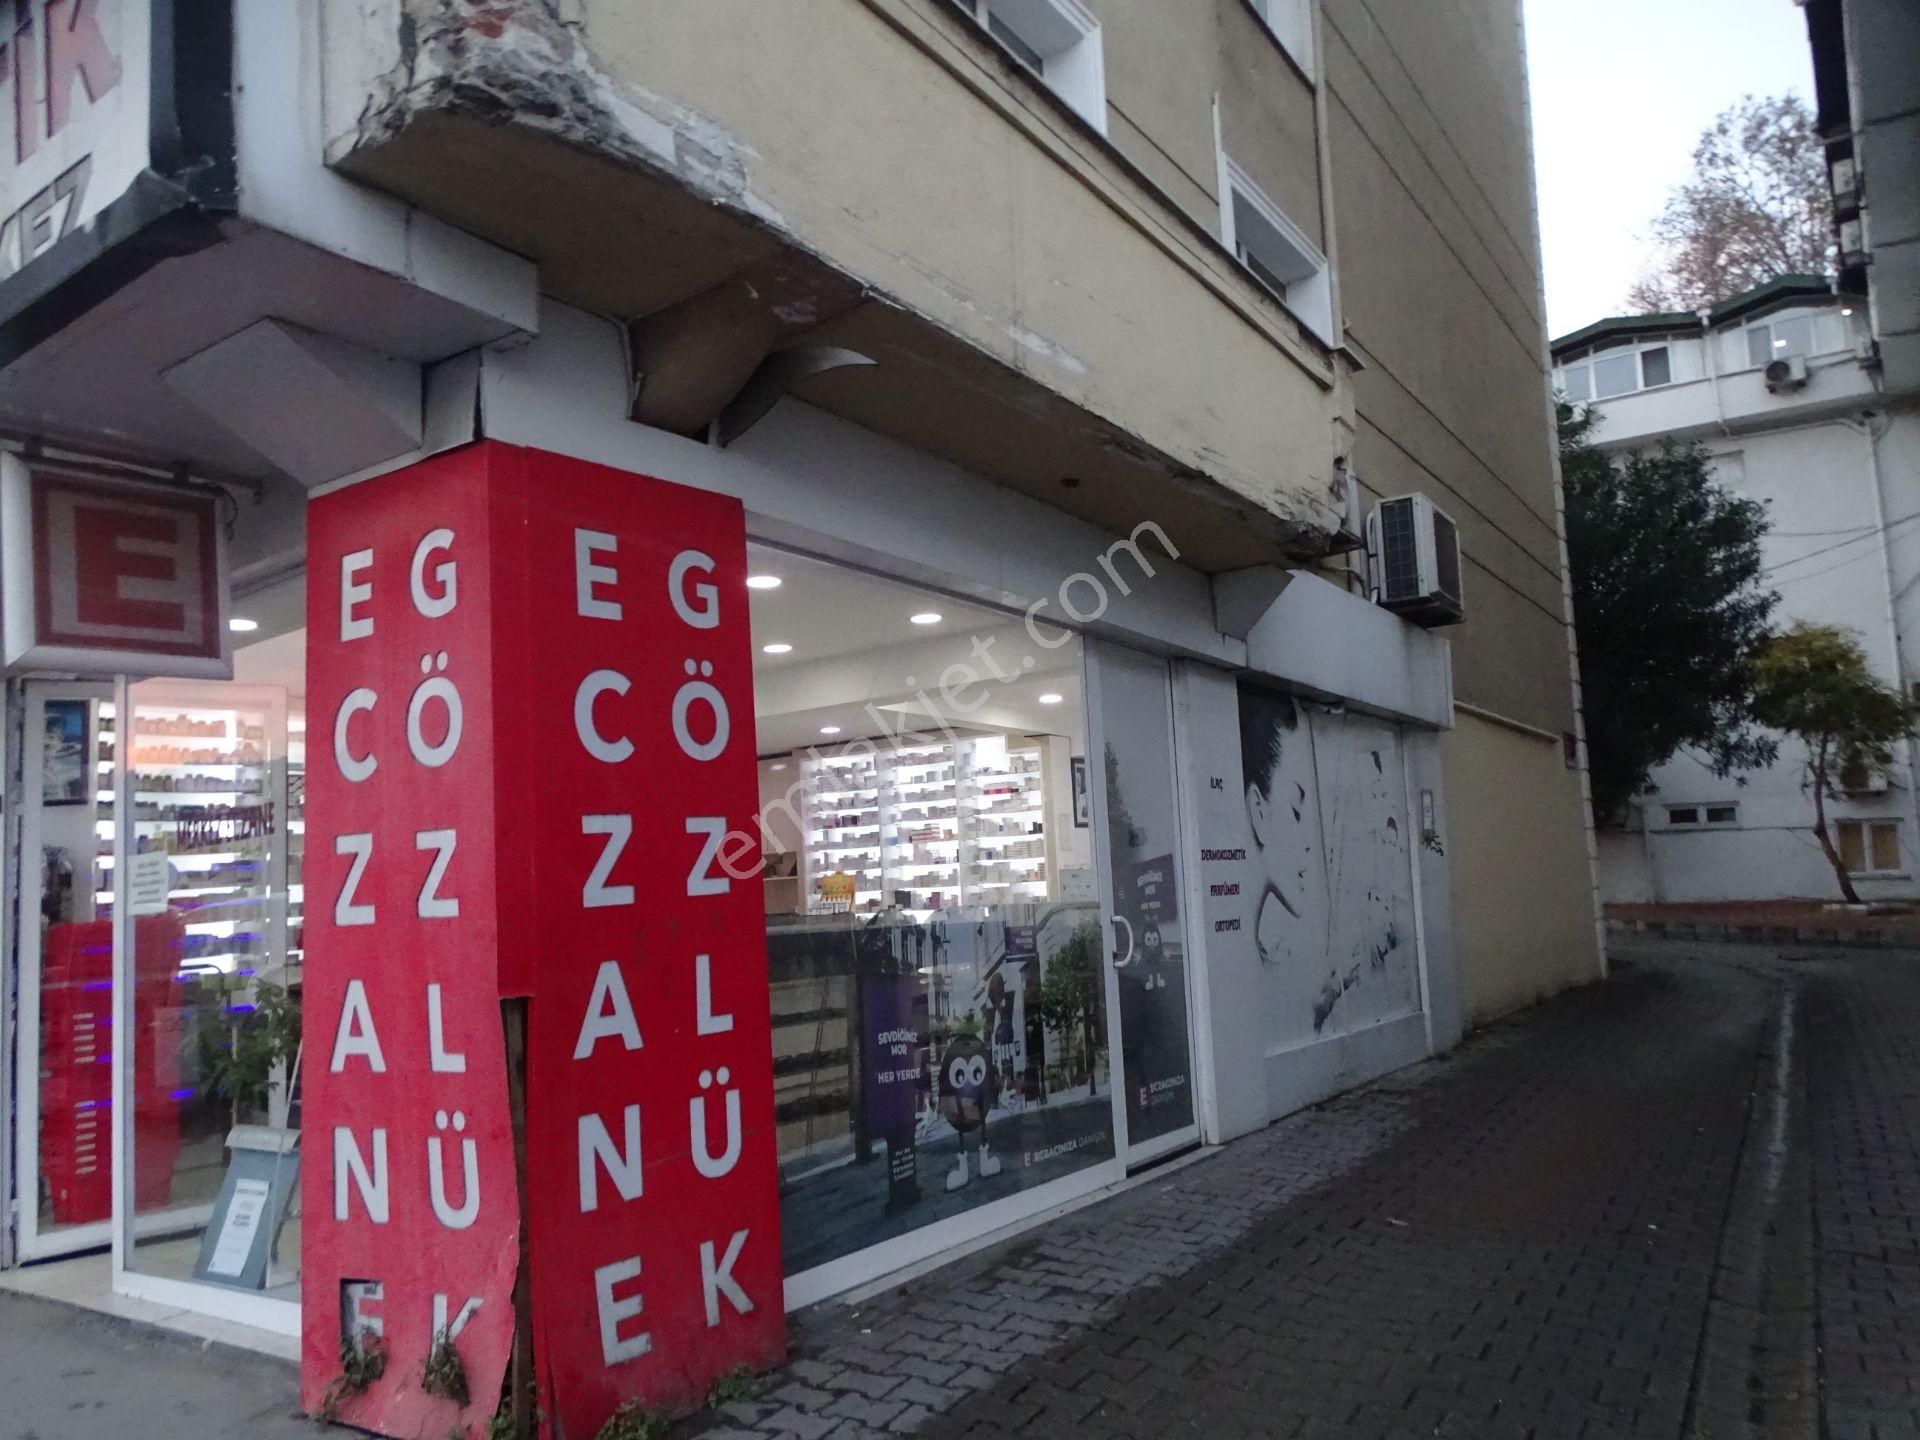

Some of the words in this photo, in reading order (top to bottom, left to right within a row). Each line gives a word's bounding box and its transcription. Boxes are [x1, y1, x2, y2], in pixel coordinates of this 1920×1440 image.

[573, 526, 654, 1368] ECZANE
[667, 549, 755, 1328] GÖZLÜK
[878, 1071, 895, 1084] HER
[896, 1067, 921, 1081] YERDE
[891, 1044, 908, 1056] MOR
